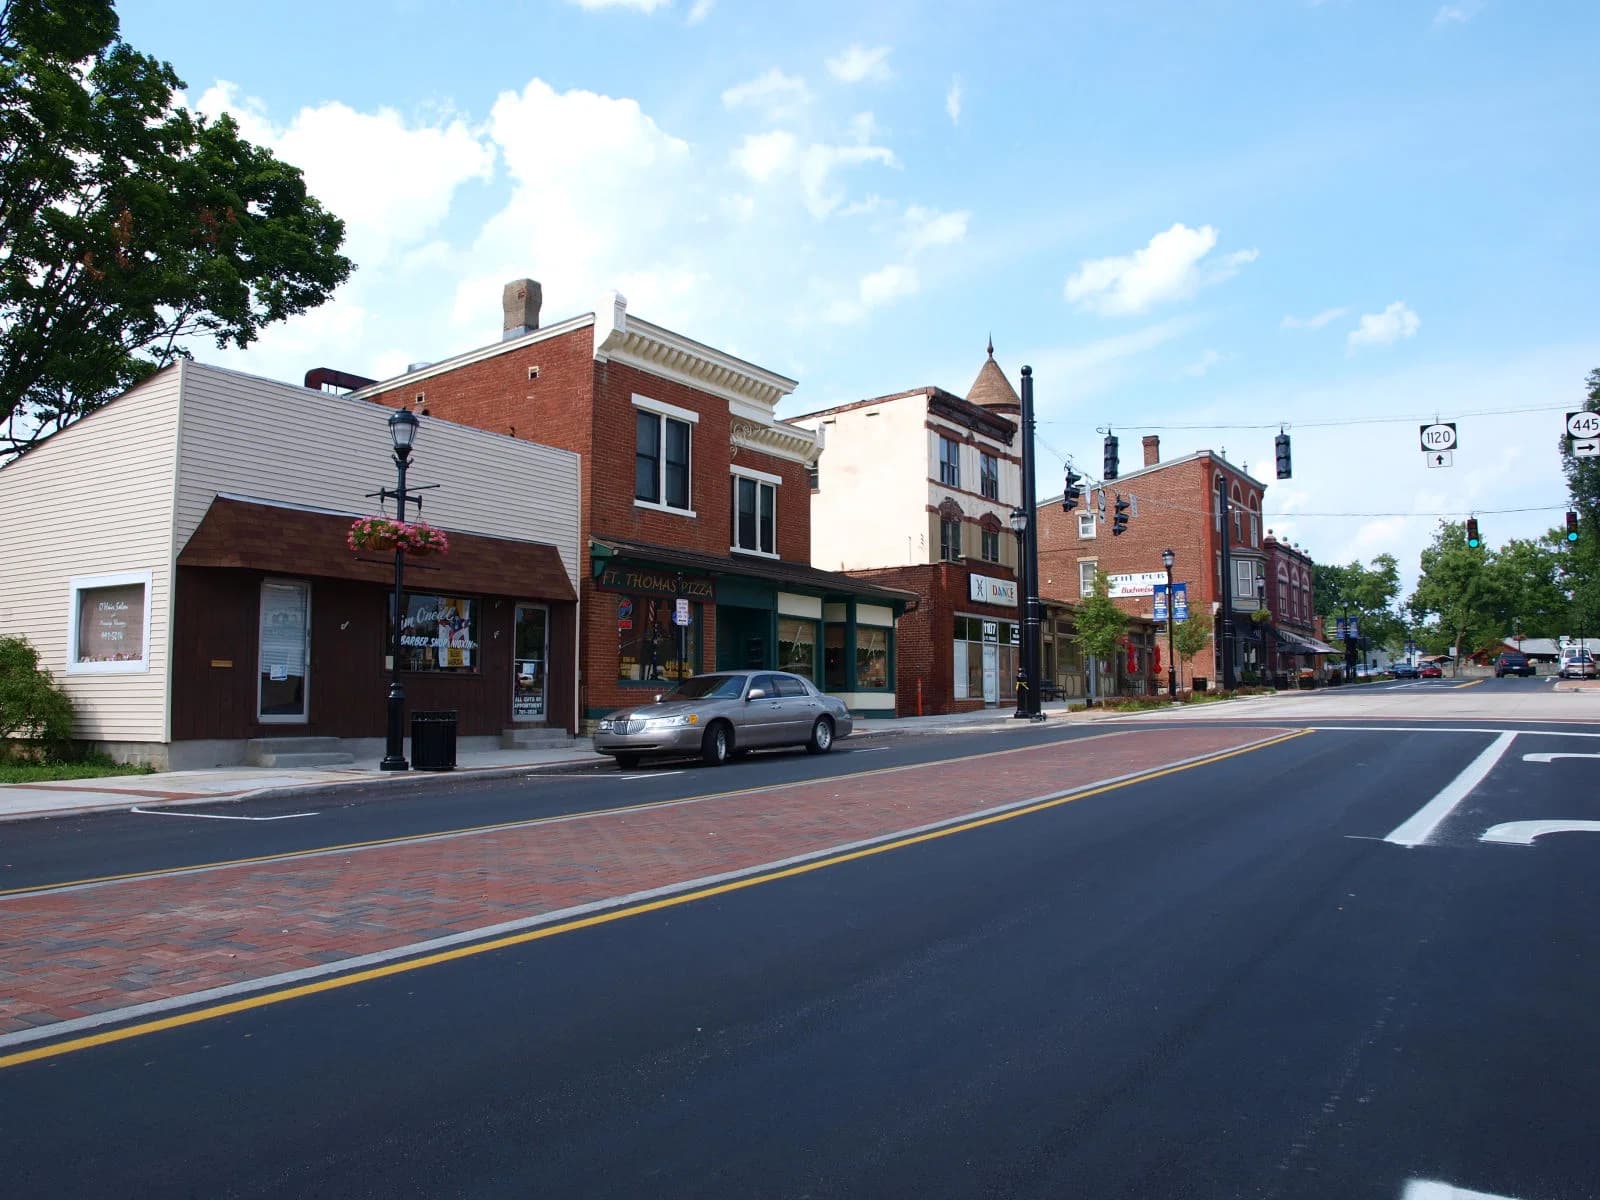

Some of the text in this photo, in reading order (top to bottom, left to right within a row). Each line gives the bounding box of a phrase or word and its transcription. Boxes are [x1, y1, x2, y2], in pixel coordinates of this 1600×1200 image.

[1573, 418, 1599, 432] 445
[1427, 430, 1451, 444] 1120
[602, 570, 713, 597] FT. THOMAS PIZZA
[1121, 586, 1154, 594] Budweise
[992, 584, 1014, 599] DANCE
[983, 622, 997, 635] 1107
[400, 635, 429, 647] BARBER
[430, 637, 448, 647] SHOP
